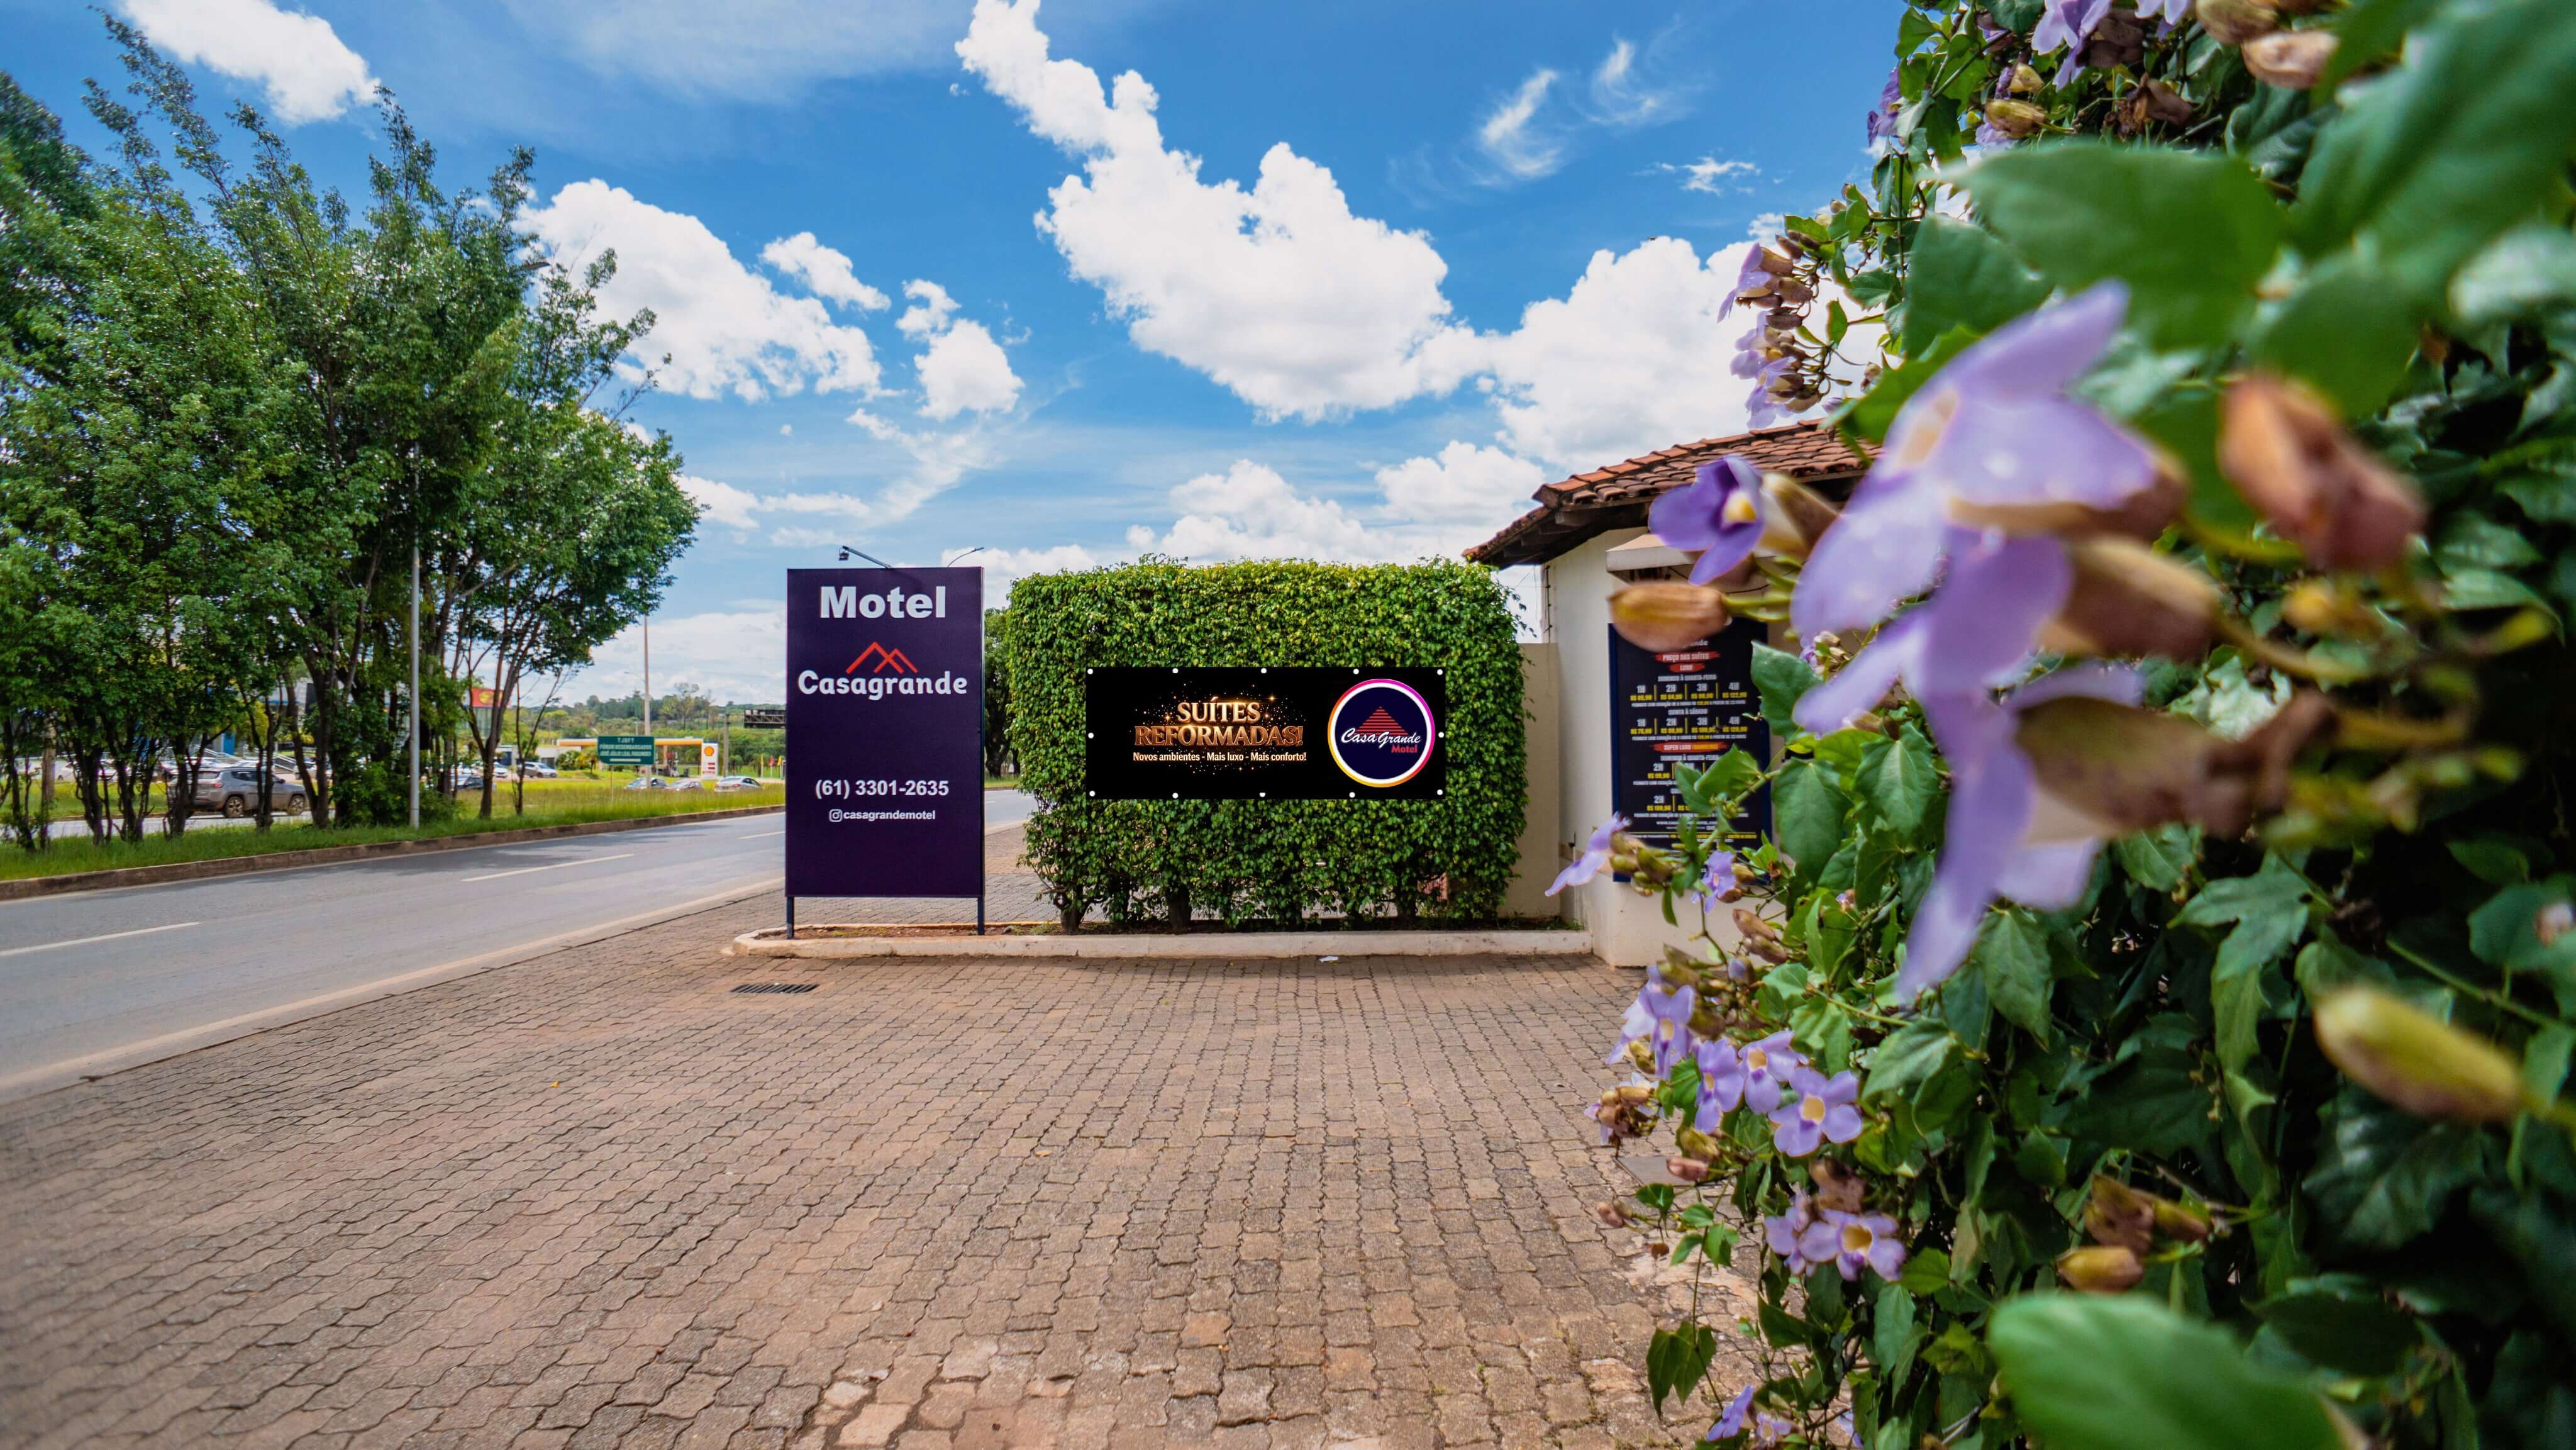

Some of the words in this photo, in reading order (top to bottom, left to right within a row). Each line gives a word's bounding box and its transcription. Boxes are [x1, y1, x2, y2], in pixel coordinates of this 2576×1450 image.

[820, 586, 946, 619] Motel
[797, 669, 967, 701] Casagrande
[1666, 684, 1677, 693] 2H
[1697, 683, 1707, 691] 3H
[1729, 682, 1740, 690] 4H
[1177, 696, 1261, 723] SUÍTES
[1666, 718, 1677, 726] 2H
[1697, 717, 1707, 725] 3H
[1729, 717, 1740, 725] 4H
[1134, 725, 1304, 747] REFORMADAS!
[1133, 752, 1158, 762] Novos
[1159, 752, 1200, 761] ambientes
[1207, 752, 1226, 761] Mais
[1227, 752, 1244, 761] luxo
[1250, 752, 1269, 761] Mais
[1270, 752, 1307, 761] conforto!
[1391, 744, 1418, 753] Motel
[816, 779, 850, 800] (61)
[855, 779, 949, 796] 3301-2635
[843, 809, 936, 822] casagrandemotel
